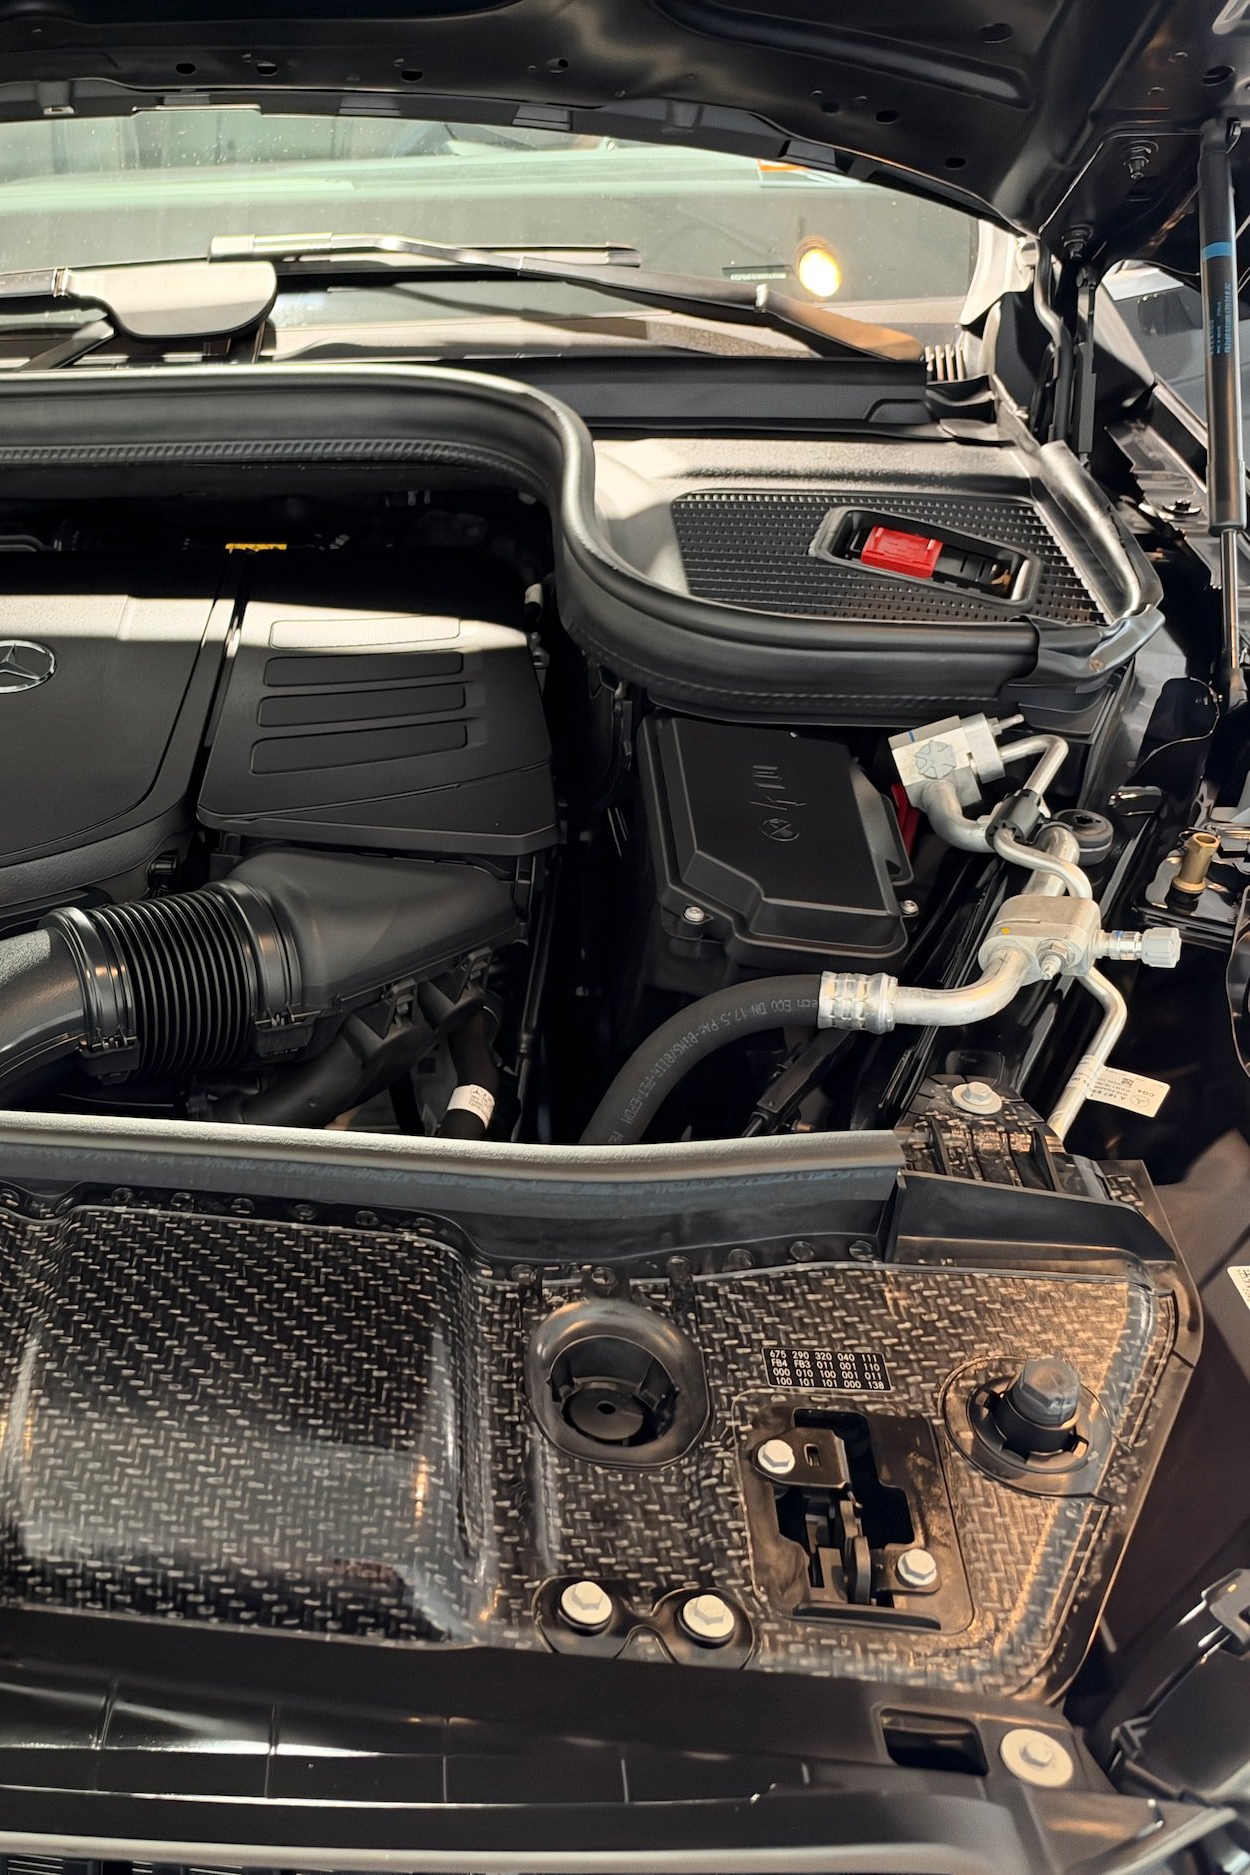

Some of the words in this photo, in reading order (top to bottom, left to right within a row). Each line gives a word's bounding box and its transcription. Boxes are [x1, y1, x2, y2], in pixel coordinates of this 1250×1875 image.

[751, 1002, 767, 1016] DN
[770, 1350, 786, 1358] 675
[792, 1351, 809, 1359] 290
[815, 1352, 832, 1360] 320
[838, 1353, 855, 1361] 040
[862, 1354, 877, 1362] 111
[772, 1359, 787, 1367] FB4
[794, 1360, 811, 1368] FB3
[817, 1361, 833, 1369] 011
[839, 1362, 856, 1370] 001
[864, 1363, 880, 1371] 110
[773, 1368, 790, 1376] 000
[796, 1368, 813, 1377] 010
[820, 1370, 836, 1378] 100
[842, 1371, 858, 1379] 001
[864, 1372, 882, 1380] 011
[776, 1377, 792, 1385] 100
[799, 1378, 814, 1386] 101
[822, 1379, 838, 1388] 101
[844, 1380, 861, 1388] 000
[868, 1381, 884, 1389] 138
